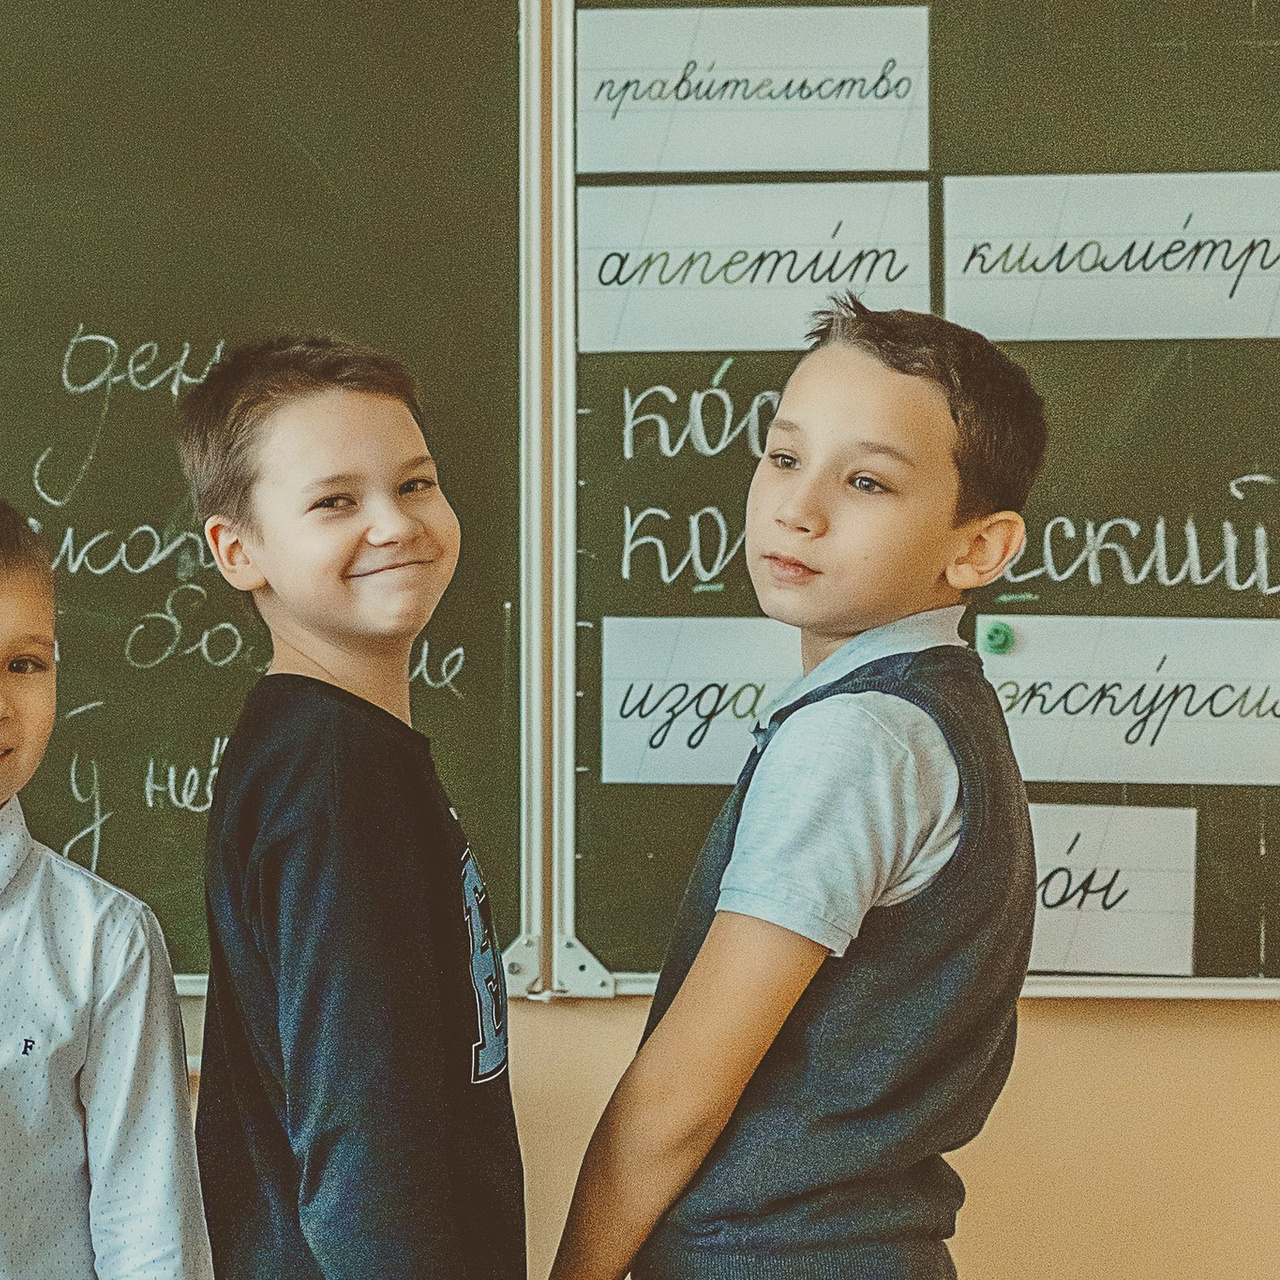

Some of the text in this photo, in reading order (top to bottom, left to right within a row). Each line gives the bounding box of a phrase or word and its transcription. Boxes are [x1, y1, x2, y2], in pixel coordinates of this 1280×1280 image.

[620, 683, 766, 750] изда
[996, 654, 1280, 746] экску́рси
[21, 1038, 35, 1056] F
